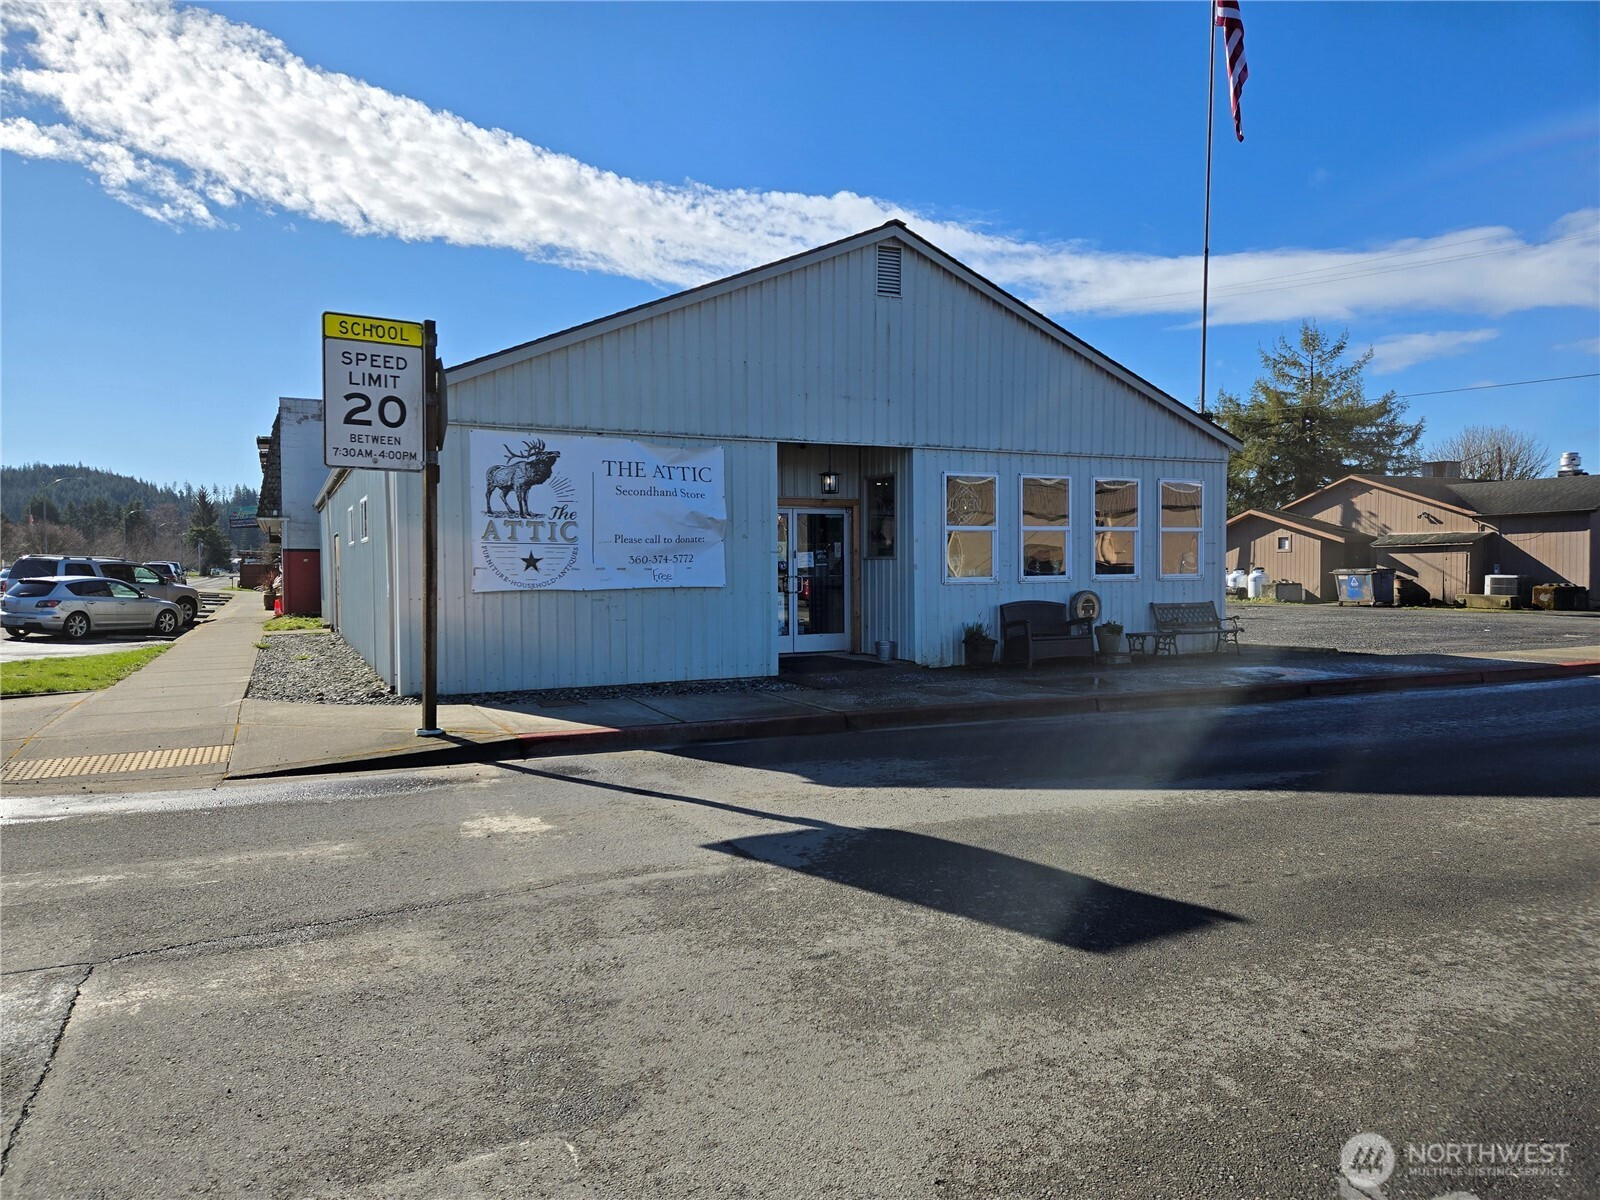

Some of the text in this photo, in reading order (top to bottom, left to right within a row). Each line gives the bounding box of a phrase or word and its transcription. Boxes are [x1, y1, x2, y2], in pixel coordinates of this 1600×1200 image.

[339, 320, 409, 342] SCHOOL
[341, 351, 408, 370] SPEED
[349, 371, 400, 389] LIMIT
[343, 392, 407, 428] 20
[350, 433, 401, 446] BETWEEN
[602, 460, 712, 483] THE ATTIC
[615, 485, 706, 499] Secondhand Store
[548, 504, 578, 520] The
[481, 520, 579, 543] ATTIC
[614, 534, 705, 544] Please call to donate:
[628, 554, 694, 565] 360-374-5772
